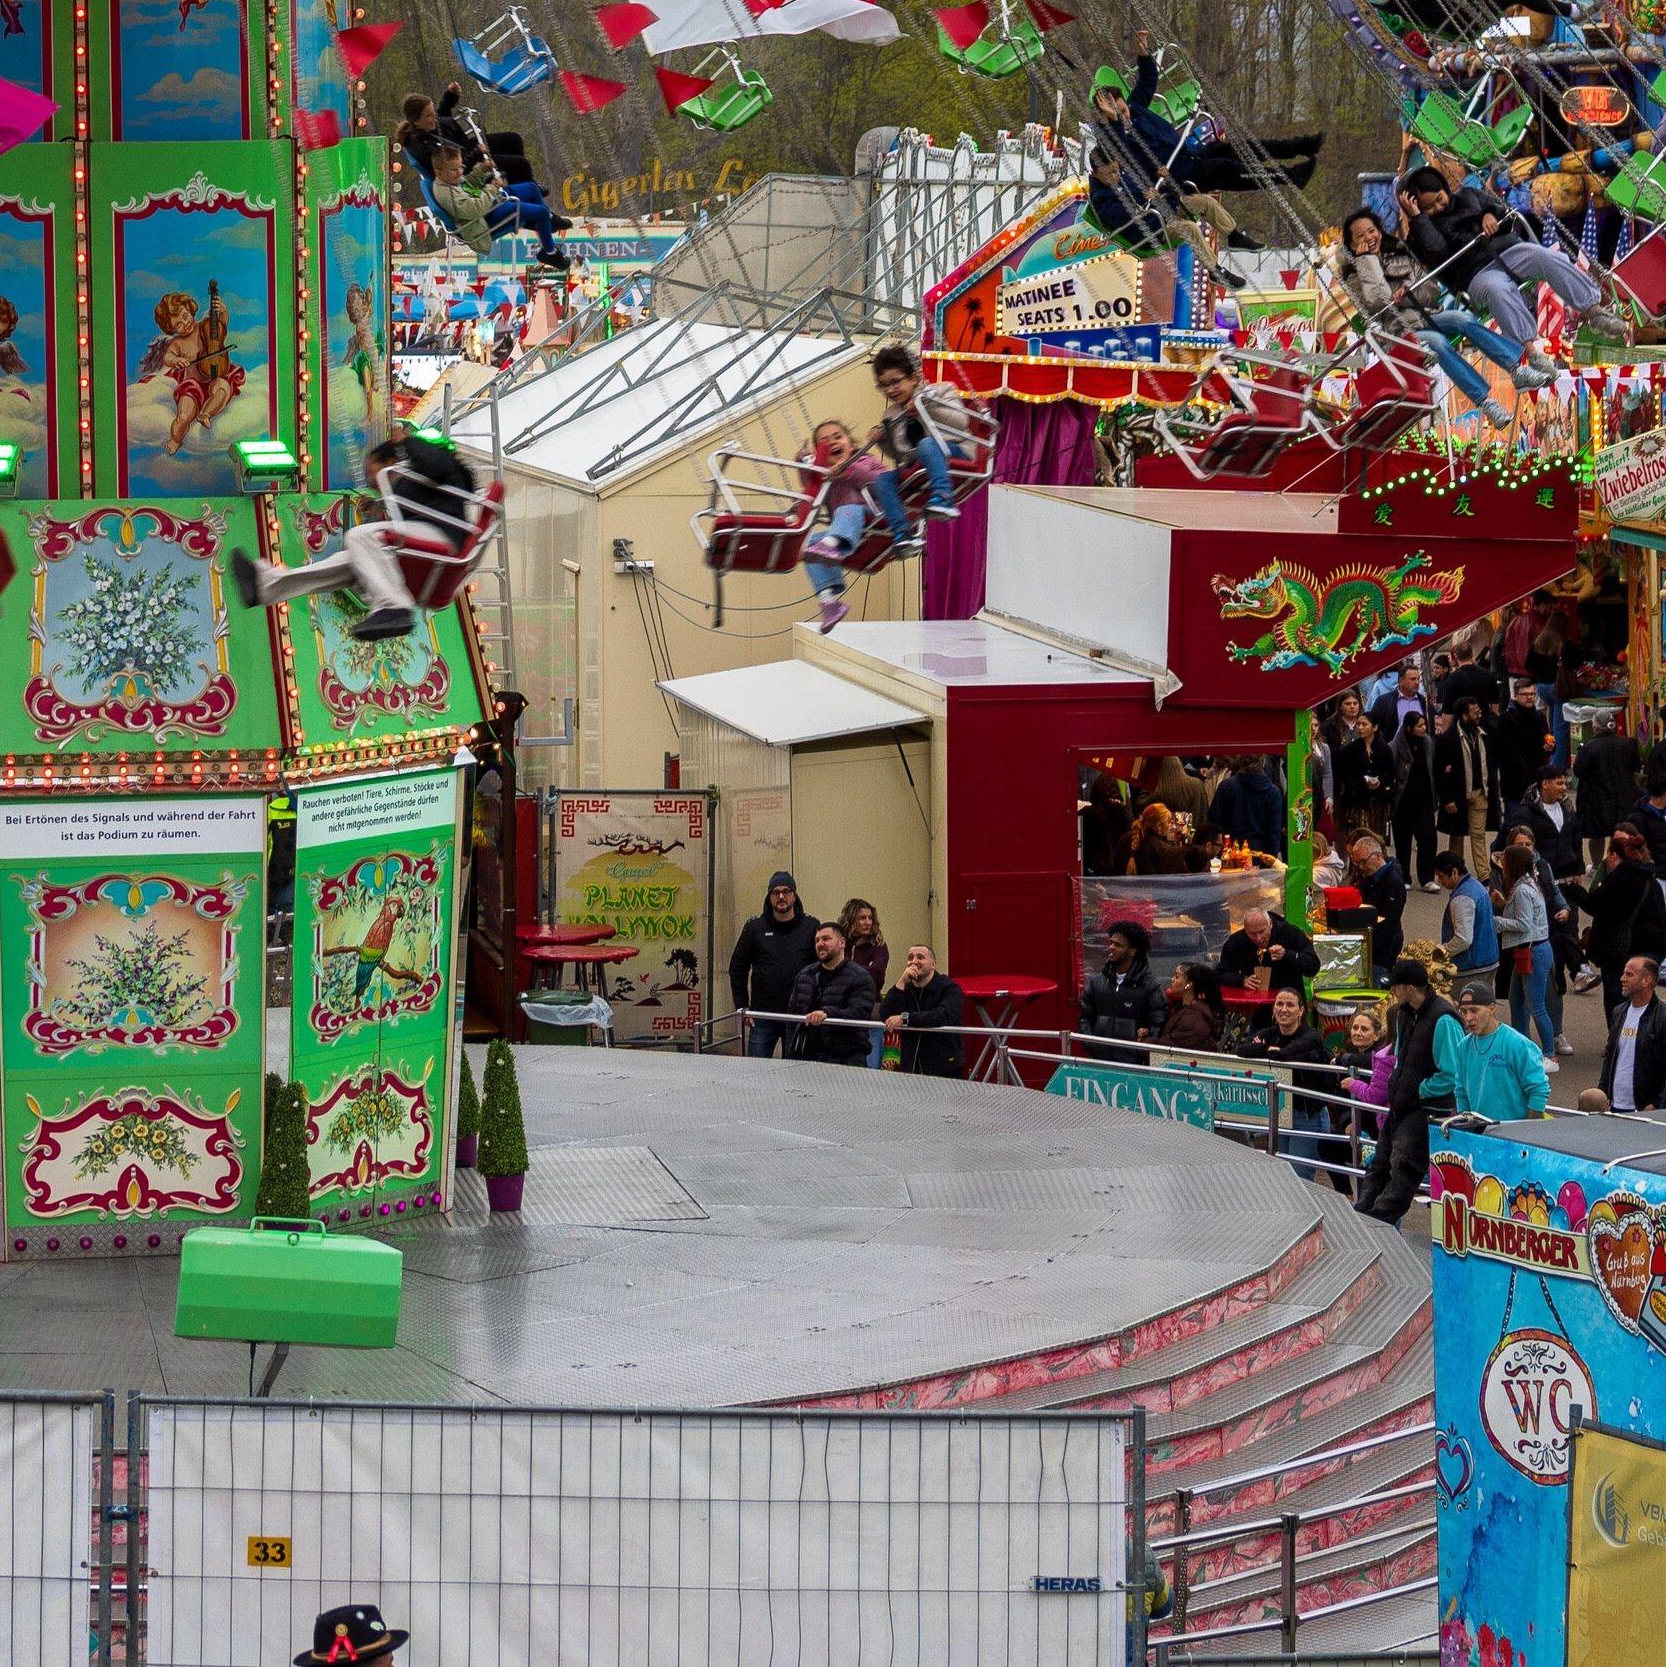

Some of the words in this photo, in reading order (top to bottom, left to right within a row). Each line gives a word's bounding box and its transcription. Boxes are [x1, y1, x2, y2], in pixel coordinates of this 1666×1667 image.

[526, 240, 646, 259] BHNEN-
[1005, 279, 1075, 309] MATINEE
[1017, 307, 1065, 326] SEATS
[1073, 297, 1132, 321] 1.00
[1596, 452, 1614, 465] chon
[1452, 493, 1475, 516] 友
[302, 798, 331, 810] Rauchen
[332, 792, 364, 805] verboten!
[366, 789, 383, 799] Tiere,
[385, 785, 413, 797] Schirme,
[414, 781, 434, 793] Stöcke
[435, 778, 449, 789] und
[5, 814, 22, 825] Bei
[25, 814, 68, 825] Ertönen
[71, 814, 89, 823] des
[92, 812, 130, 825] Signals
[133, 812, 154, 822] und
[157, 811, 205, 821] während
[207, 811, 226, 820] der
[228, 810, 256, 820] Fahrt
[311, 810, 335, 822] andere
[336, 805, 373, 820] gefährliche
[374, 798, 416, 813] Gegenstände
[417, 795, 439, 805] dürfen
[328, 822, 345, 833] nicht
[346, 816, 393, 831] mitgenommen
[394, 810, 422, 822] werden!
[61, 831, 74, 841] ist
[76, 831, 95, 840] das
[98, 830, 138, 840] Podium
[141, 831, 154, 839] zu
[157, 829, 201, 839] räumen.
[584, 884, 680, 912] PLANET
[1065, 1076, 1190, 1124] EINGANG
[1445, 1198, 1578, 1270] NÜRNBERGER
[1606, 1251, 1629, 1272] Gruß
[1631, 1252, 1646, 1266] aus
[1501, 1378, 1572, 1436] WC
[253, 1540, 286, 1563] 33
[1035, 1576, 1101, 1592] HERAS
